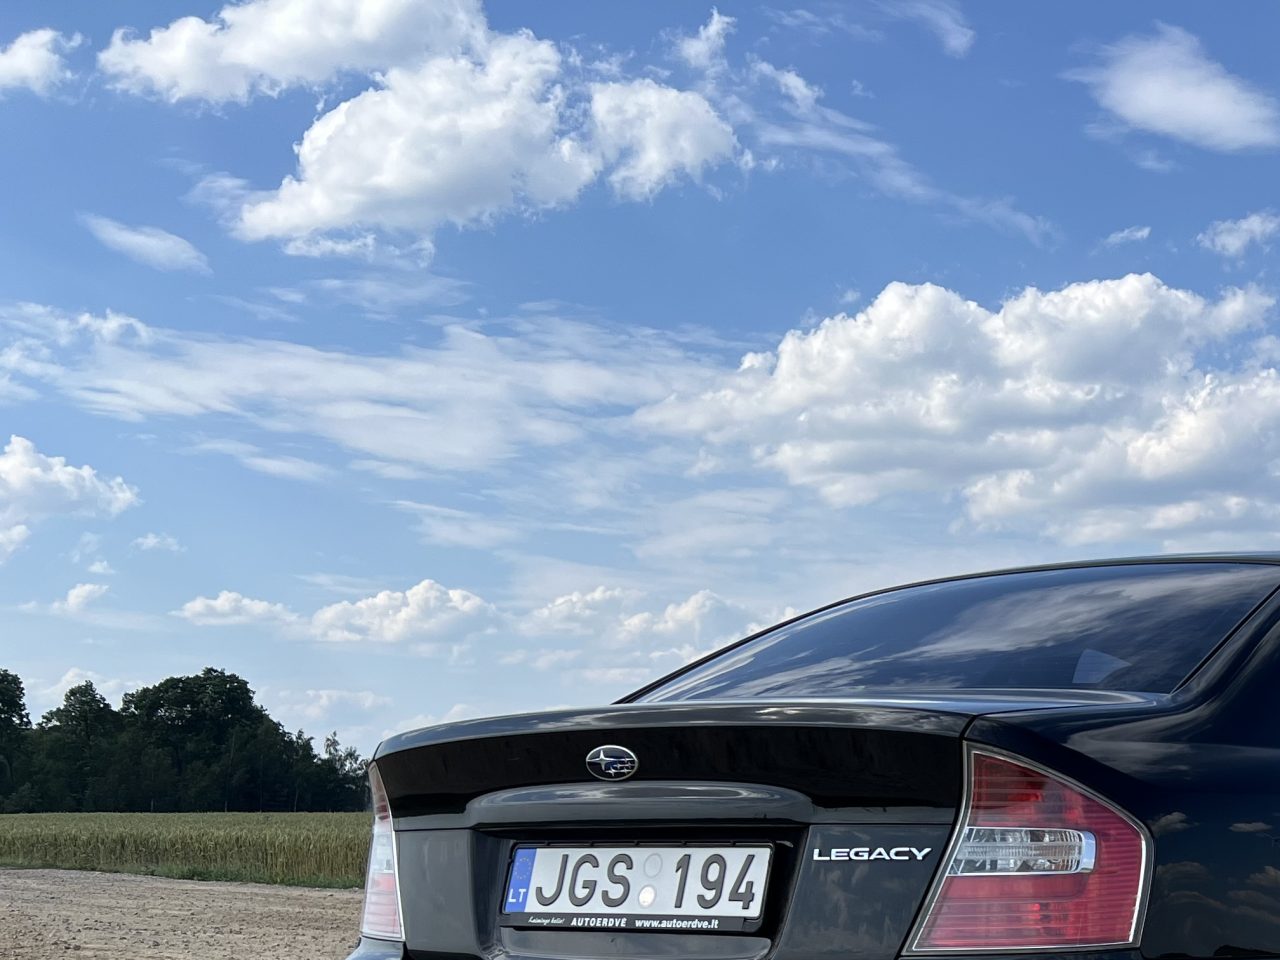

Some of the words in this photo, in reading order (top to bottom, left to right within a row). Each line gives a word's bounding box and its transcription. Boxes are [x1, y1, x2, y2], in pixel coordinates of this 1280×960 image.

[813, 847, 932, 861] LEGACY
[535, 853, 633, 907] JGS
[674, 853, 755, 910] 194
[508, 888, 527, 903] LT
[571, 917, 627, 928] AUTOERDVĖ
[635, 918, 719, 929] www.autoerdve.lt
